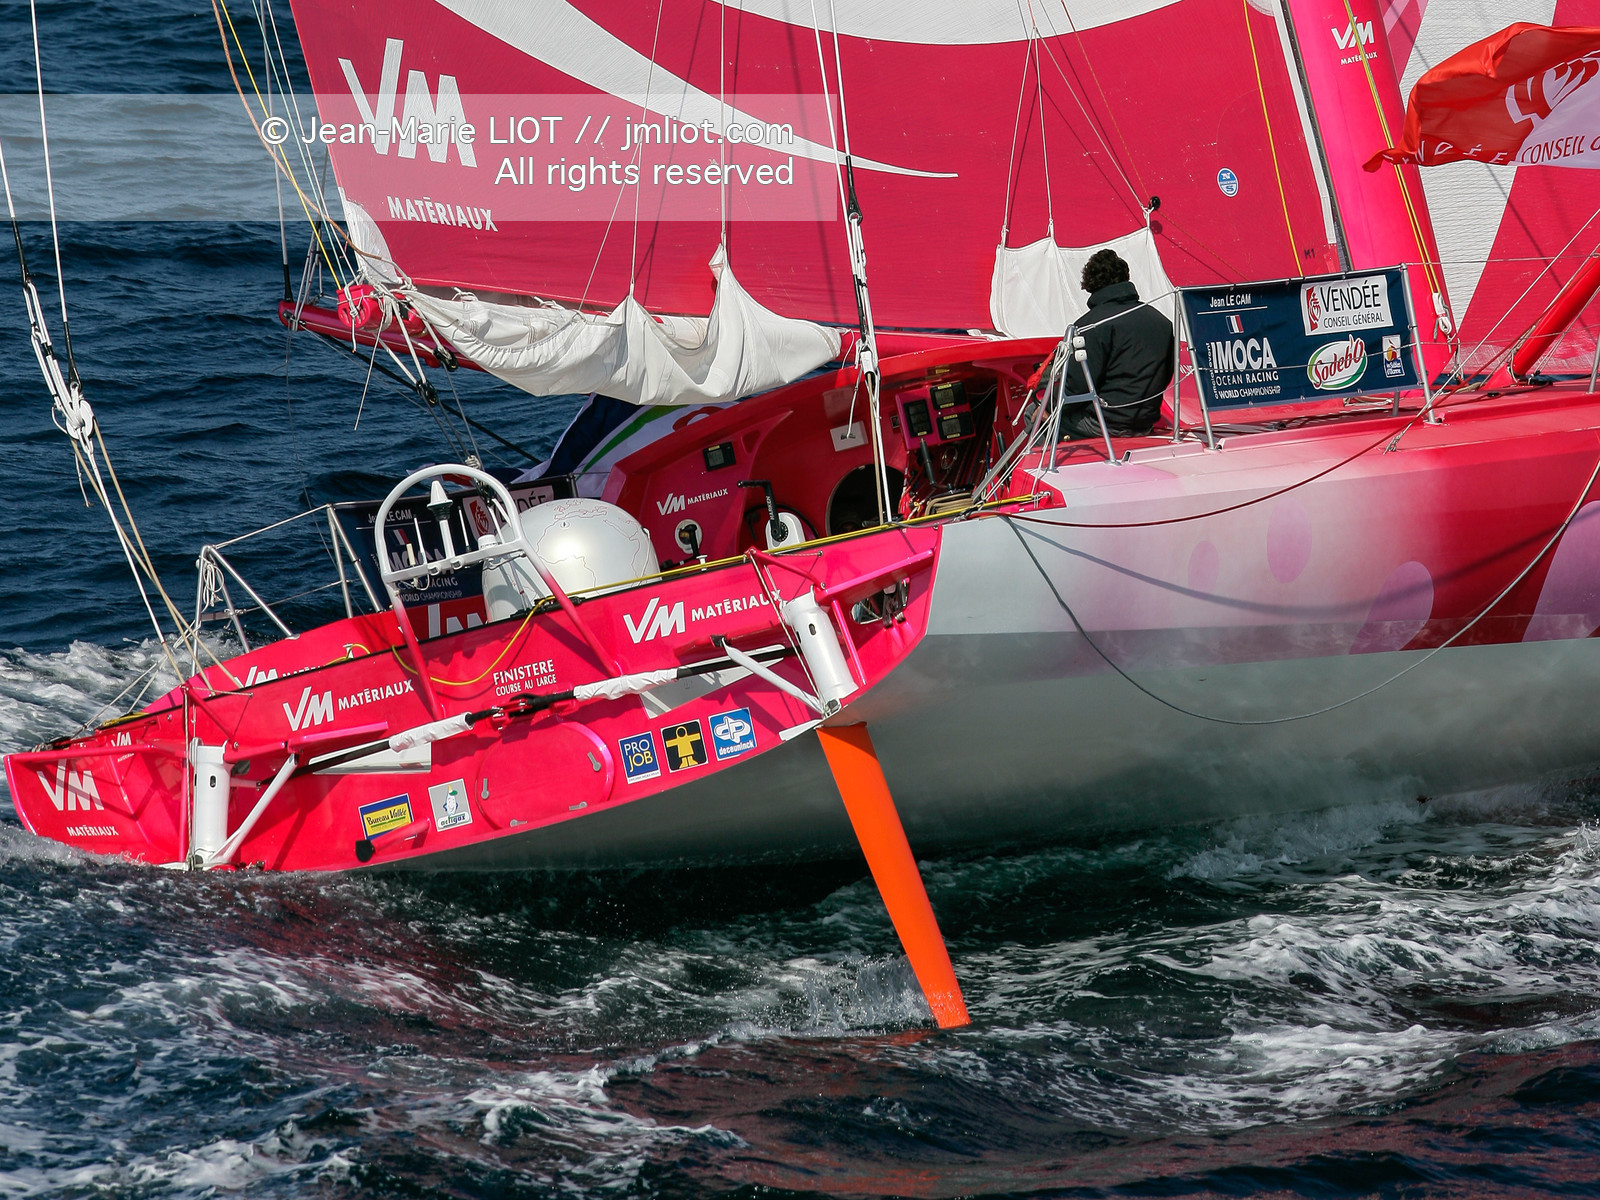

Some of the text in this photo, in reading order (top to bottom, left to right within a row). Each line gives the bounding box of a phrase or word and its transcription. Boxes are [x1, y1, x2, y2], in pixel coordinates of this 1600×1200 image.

[1331, 16, 1375, 50] VM
[338, 38, 477, 168] VM
[1521, 135, 1585, 164] CONSEIL
[1210, 294, 1251, 308] Jean LE CAM
[1320, 280, 1381, 312] VENDÉE
[1324, 312, 1385, 329] CONSEIL GÉNÉRAL
[1211, 337, 1277, 373] IMOCA
[1216, 371, 1279, 386] OCEAN RACING
[1218, 386, 1281, 399] WORLD CHAMPIONSHIP
[395, 509, 413, 521] CAM
[656, 492, 686, 516] VM
[623, 597, 686, 644] VM
[493, 659, 555, 685] FINISTERE
[495, 673, 557, 697] COURSE AU LARGE
[282, 686, 334, 732] VM
[624, 739, 650, 756] PRO
[629, 751, 653, 772] JOB
[36, 758, 104, 811] VM
